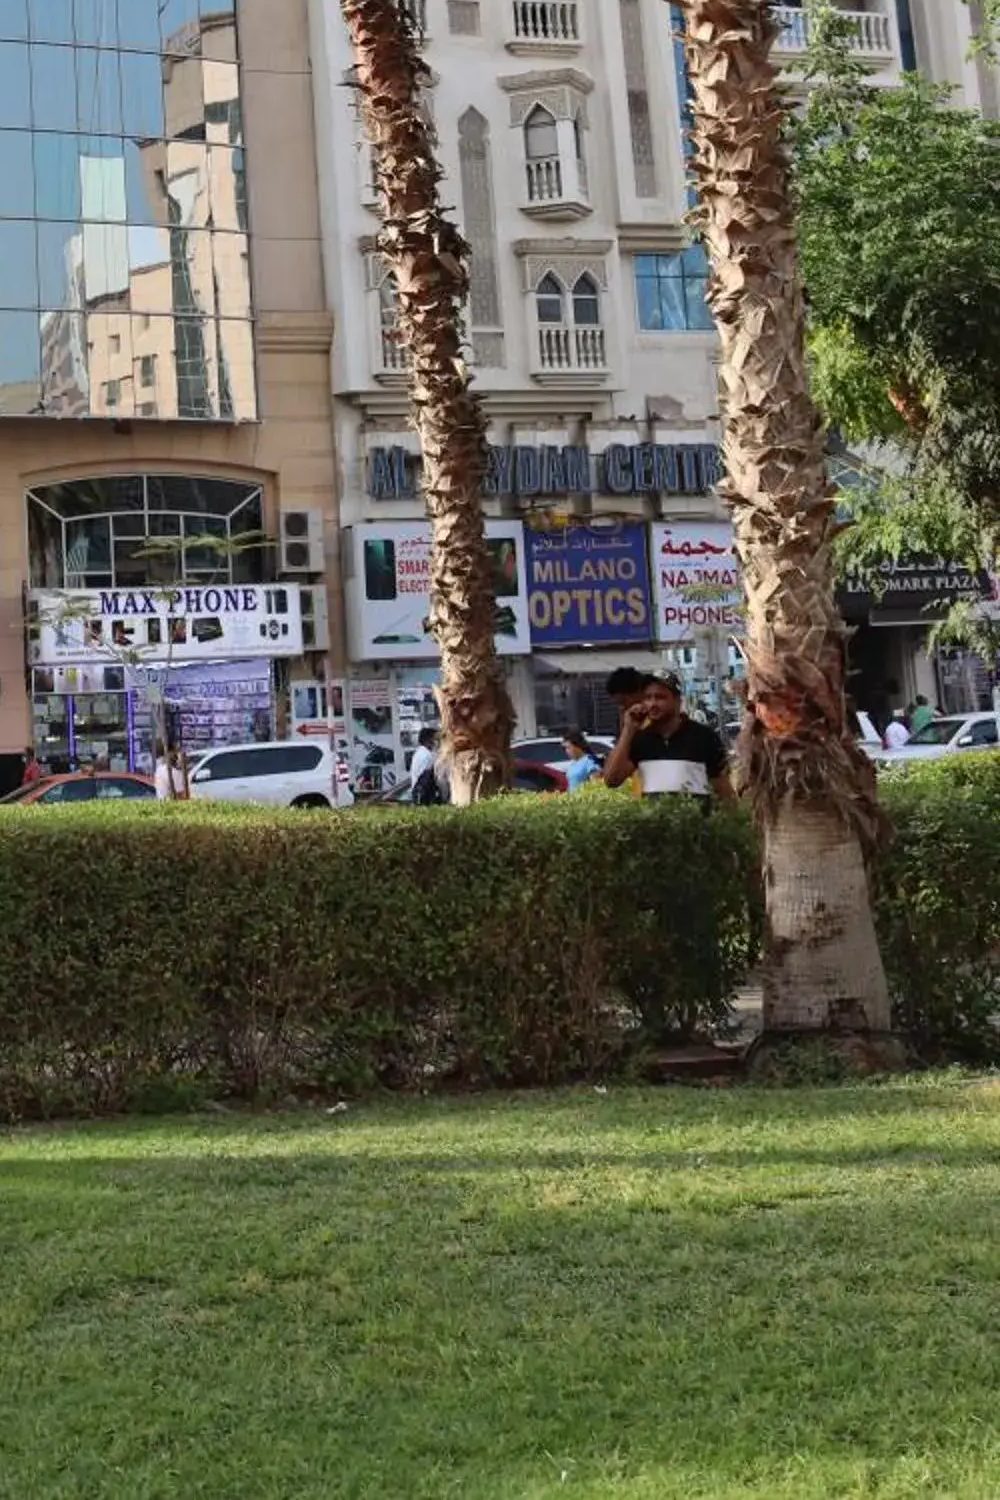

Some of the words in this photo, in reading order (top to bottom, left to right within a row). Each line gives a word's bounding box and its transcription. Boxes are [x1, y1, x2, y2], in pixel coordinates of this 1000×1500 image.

[604, 442, 724, 492] CENTR
[397, 559, 429, 574] SMAR
[533, 558, 635, 583] MILANO
[399, 579, 429, 593] ELECT
[935, 576, 980, 589] PLAZA
[100, 590, 156, 615] MAX
[168, 588, 257, 613] PHONE
[529, 588, 646, 628] OPTICS
